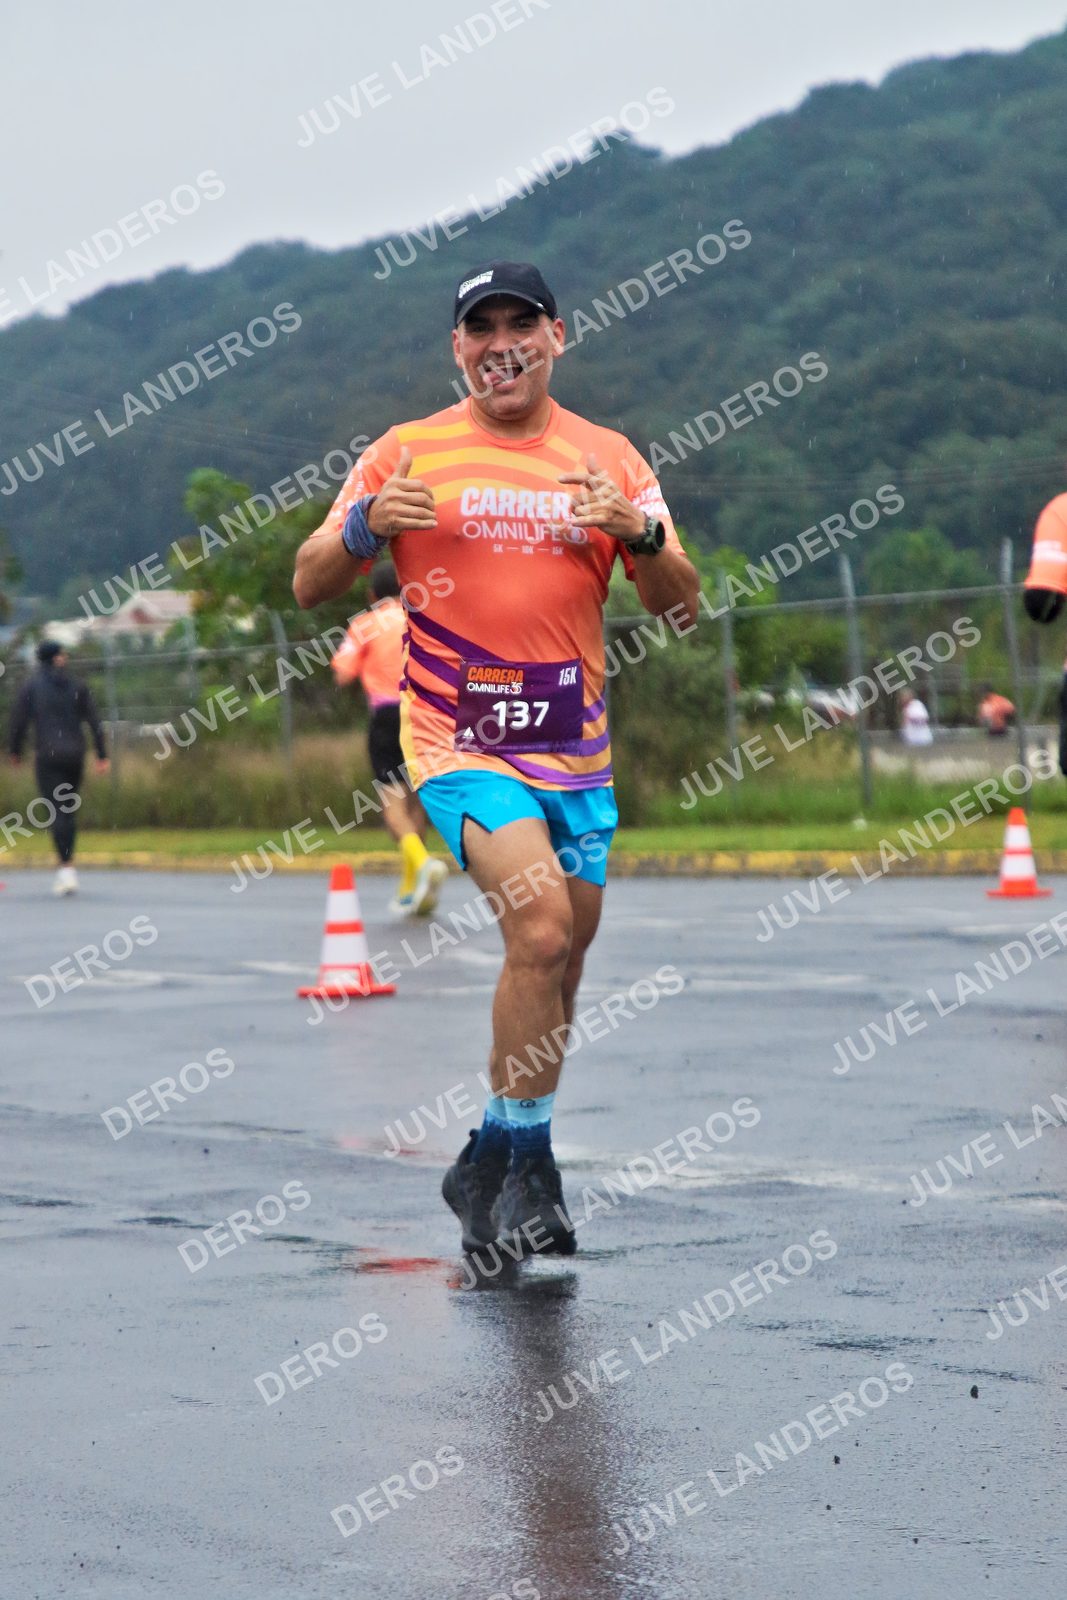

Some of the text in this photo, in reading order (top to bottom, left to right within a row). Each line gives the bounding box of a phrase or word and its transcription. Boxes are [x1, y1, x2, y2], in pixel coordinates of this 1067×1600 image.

[461, 486, 574, 520] CARRER
[463, 520, 561, 543] OMNILIFE
[467, 666, 524, 683] CARRERA
[559, 666, 578, 686] 15K
[492, 700, 550, 727] 137
